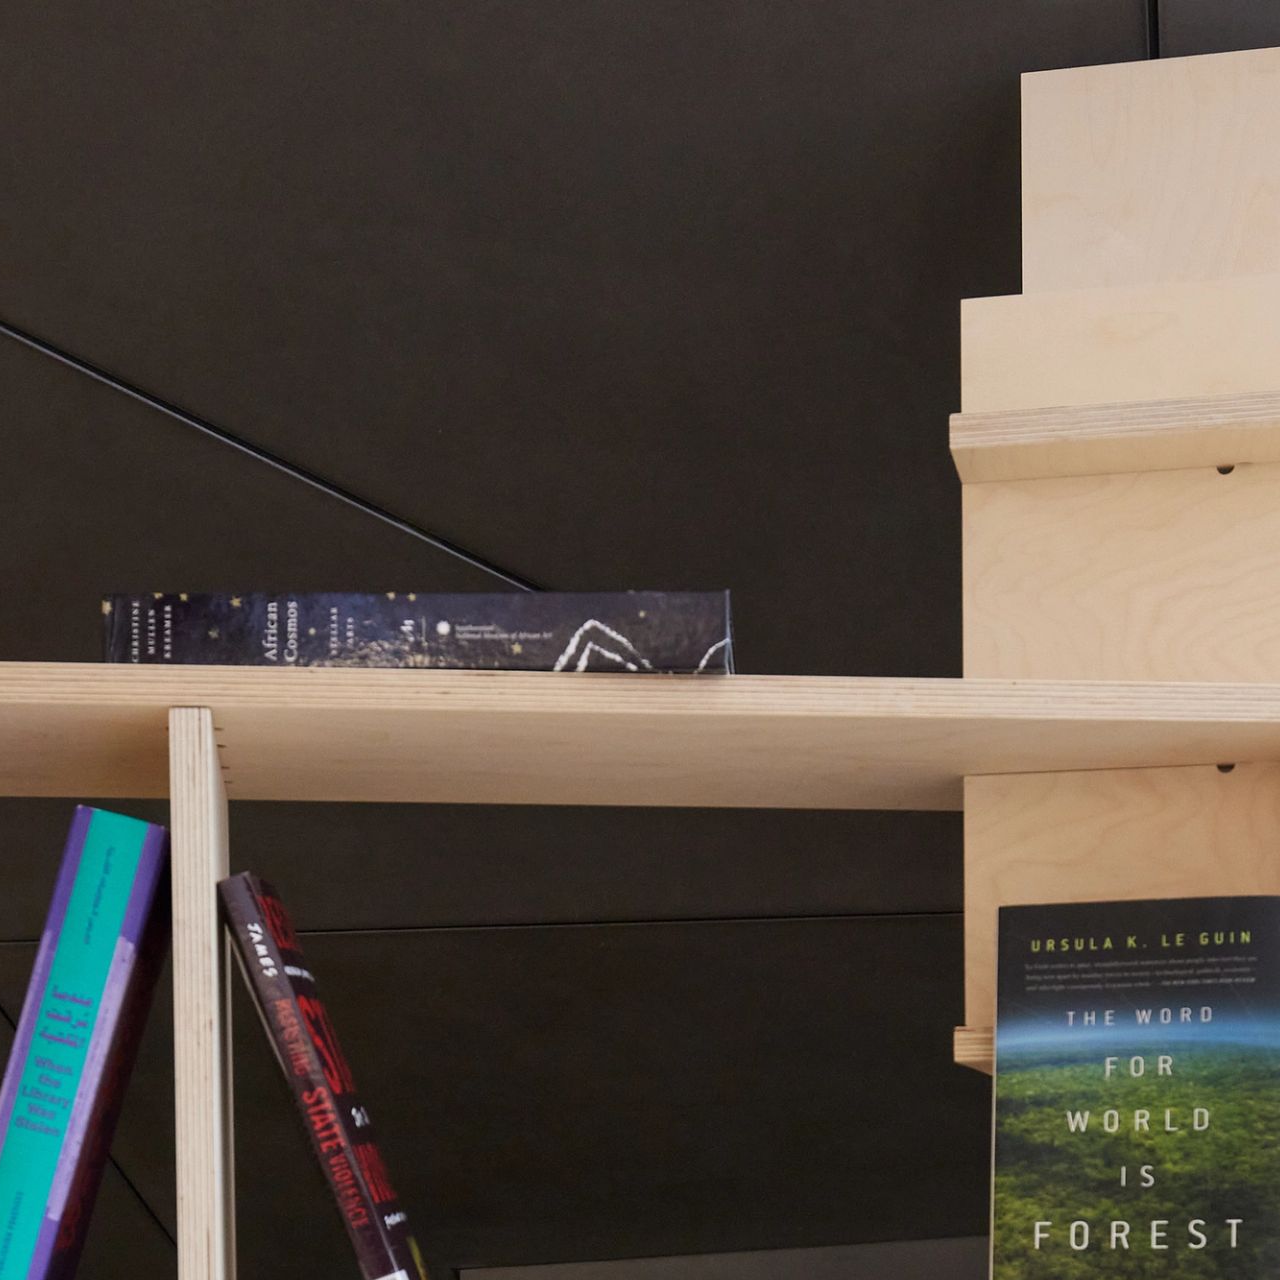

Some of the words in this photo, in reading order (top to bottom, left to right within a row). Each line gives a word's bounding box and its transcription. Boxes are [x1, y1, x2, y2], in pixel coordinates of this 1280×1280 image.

[262, 601, 278, 661] African
[284, 601, 298, 662] Cosmos
[1031, 937, 1114, 953] URSULA
[1127, 935, 1149, 949] K.
[1161, 933, 1185, 948] LE
[1199, 930, 1253, 946] GUIN
[1067, 1009, 1116, 1027] THE
[1135, 1006, 1214, 1025] WORD
[247, 922, 279, 978] JAMES
[301, 1086, 348, 1153] STATE
[328, 1150, 371, 1230] VIOLENCE
[1104, 1055, 1174, 1080] FOR
[1067, 1107, 1210, 1133] WORLD
[1120, 1164, 1156, 1188] IS
[1033, 1218, 1244, 1250] FOREST
